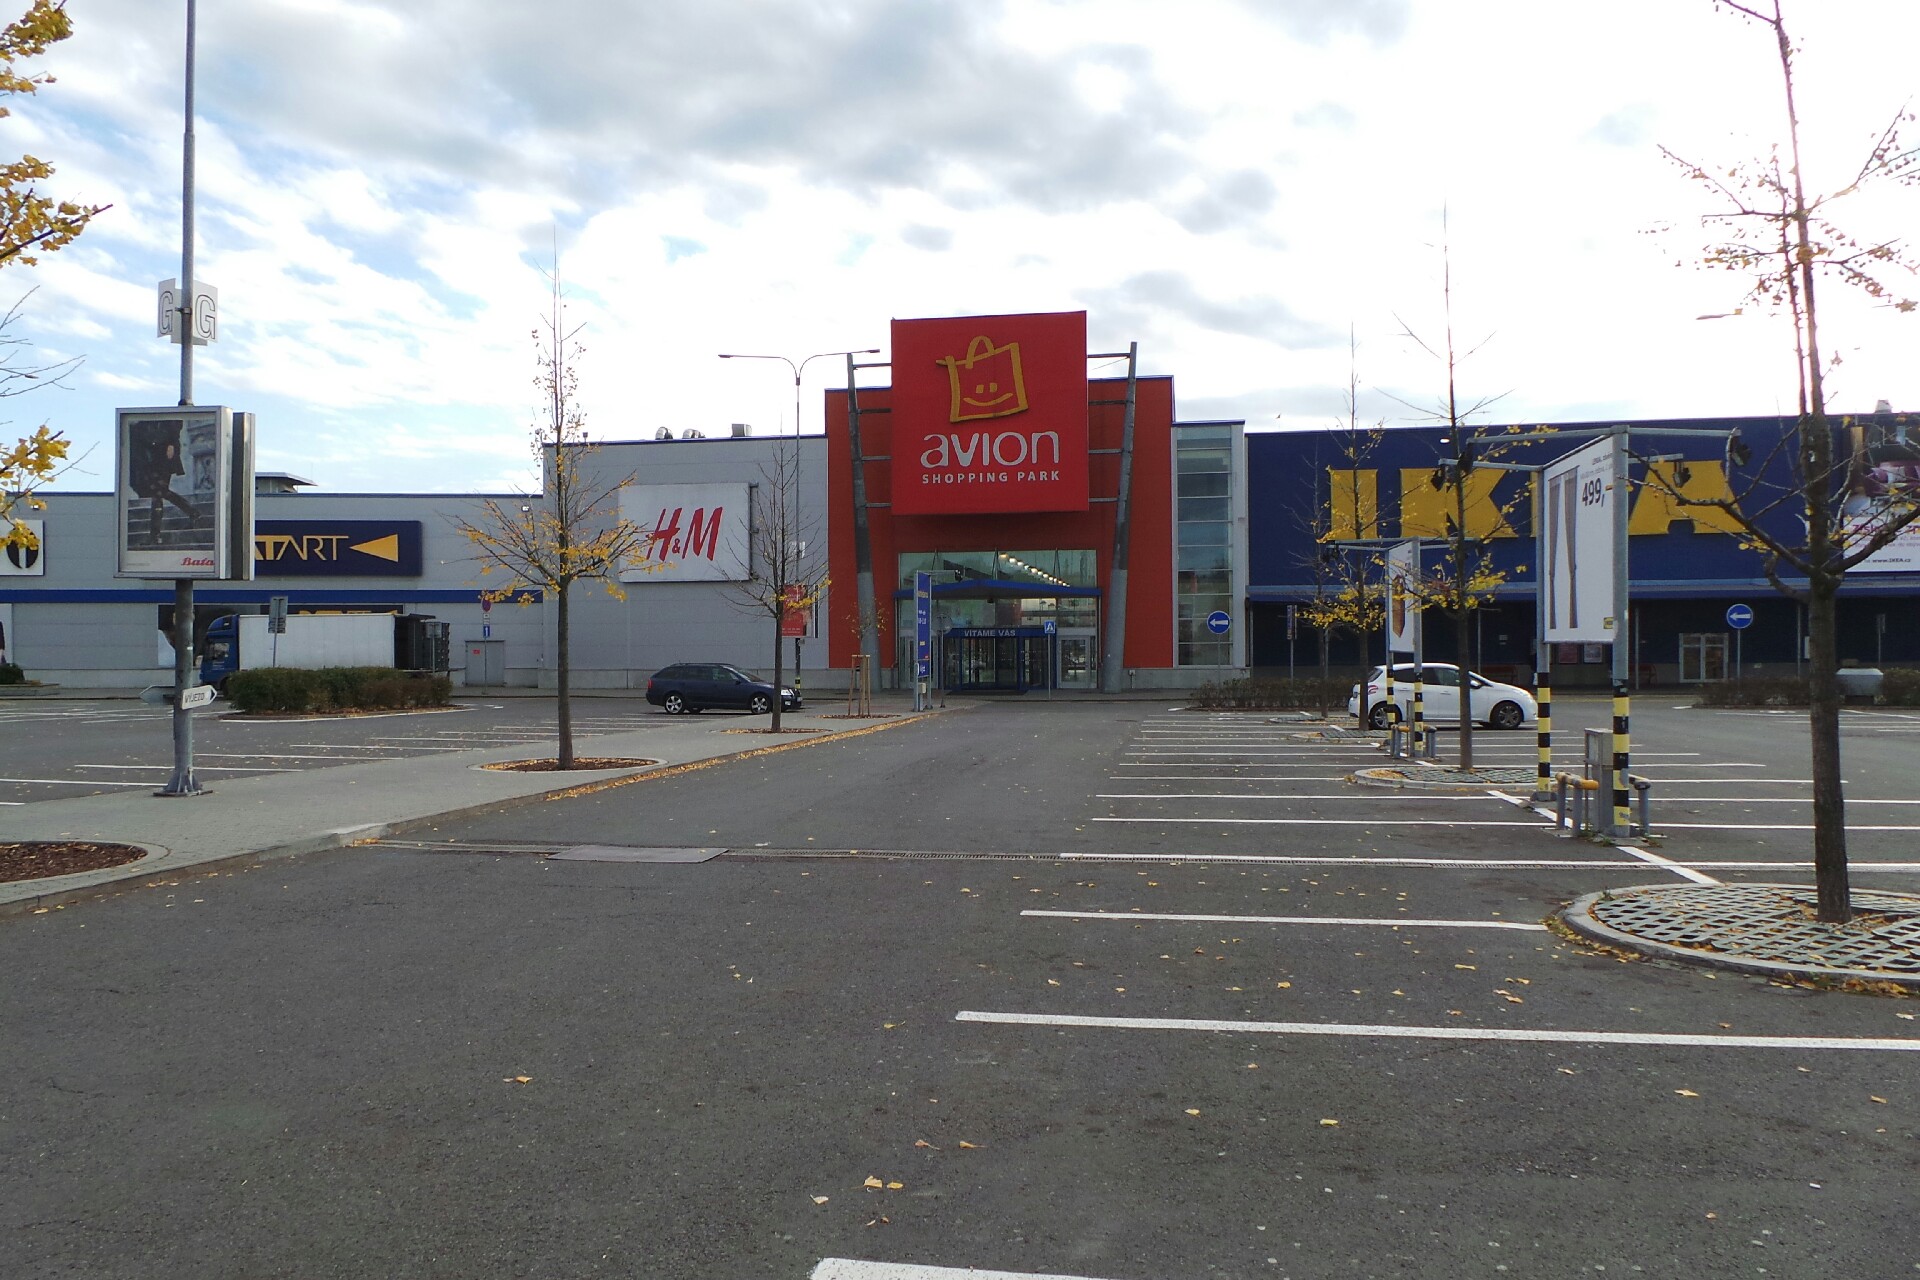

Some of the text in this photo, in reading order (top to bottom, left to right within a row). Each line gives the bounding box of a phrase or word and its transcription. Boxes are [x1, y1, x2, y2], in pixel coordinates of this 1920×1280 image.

[160, 290, 174, 335] G
[195, 294, 216, 340] G
[922, 470, 1060, 484] SHOPPING PARK
[646, 506, 723, 561] H&M
